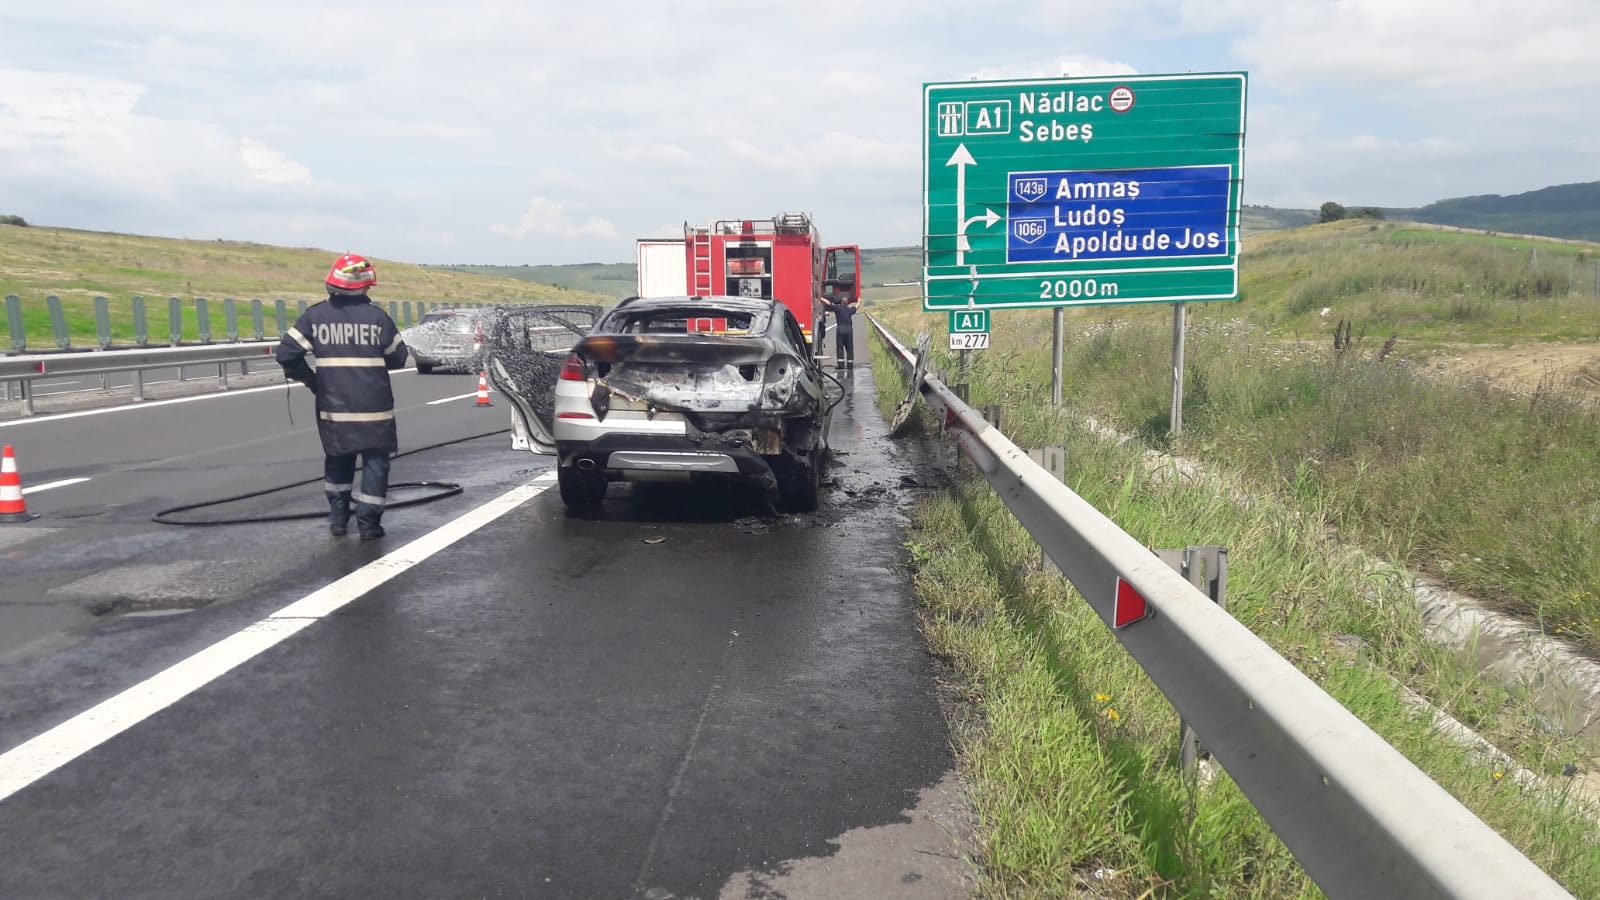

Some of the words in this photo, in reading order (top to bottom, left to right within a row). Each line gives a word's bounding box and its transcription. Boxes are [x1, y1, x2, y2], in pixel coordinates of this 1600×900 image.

[1019, 91, 1104, 114] Nădlac
[975, 107, 1001, 129] A1
[1019, 119, 1093, 144] Sebeș
[1019, 181, 1044, 195] 143B
[1055, 177, 1140, 200] Amnaș
[1054, 204, 1125, 228] Ludoș
[1019, 222, 1043, 236] 106G
[1053, 230, 1138, 259] Apoldu
[1142, 228, 1170, 251] de
[1175, 227, 1220, 249] Jos
[1039, 278, 1098, 299] 2000
[1100, 281, 1119, 296] m
[961, 314, 979, 328] A1
[951, 337, 963, 345] km
[964, 334, 987, 348] 277
